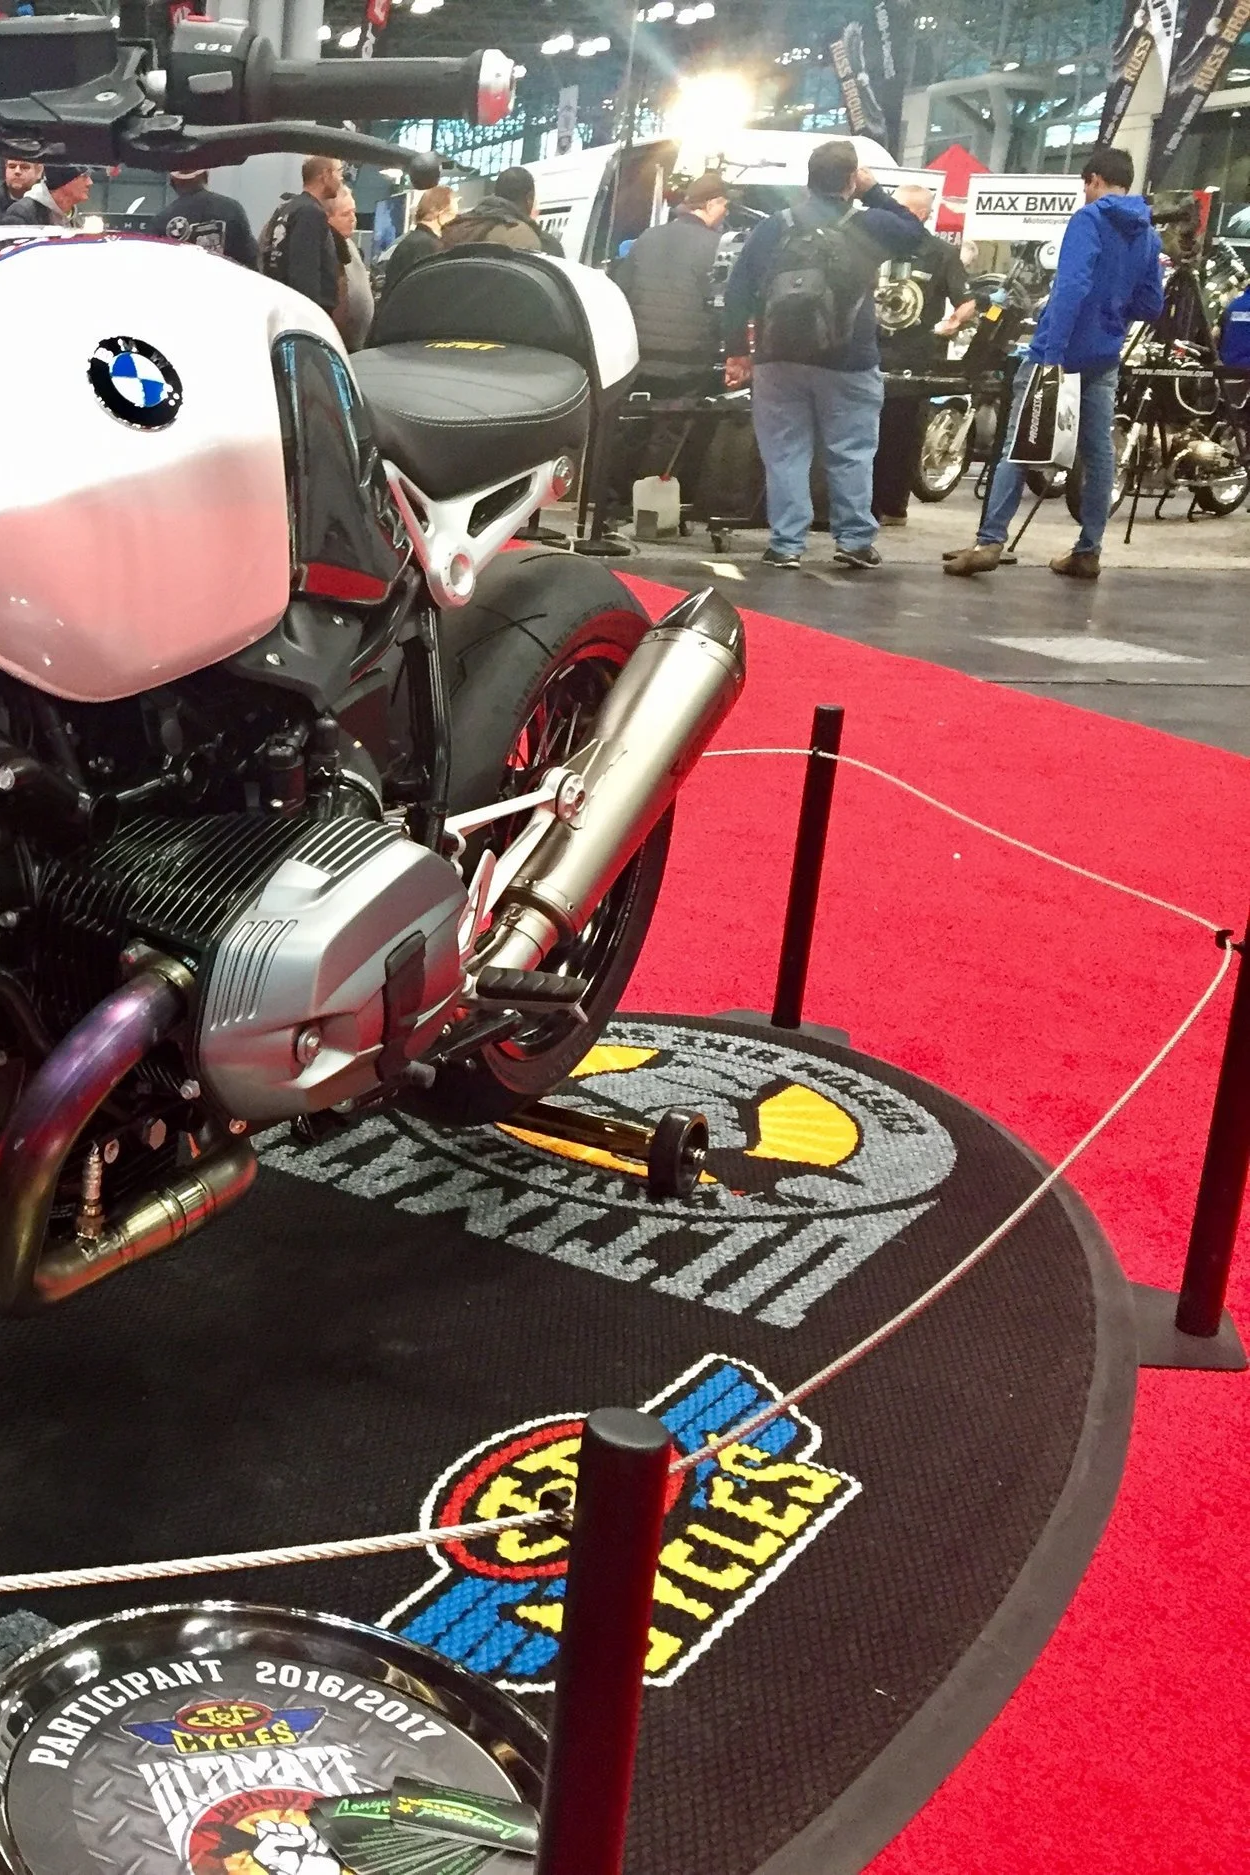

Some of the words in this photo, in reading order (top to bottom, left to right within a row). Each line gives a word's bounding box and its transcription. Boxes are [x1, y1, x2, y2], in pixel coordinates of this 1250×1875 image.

[1124, 34, 1152, 82] RUSS
[1193, 44, 1231, 93] RUSS
[842, 79, 866, 131] BROWN
[975, 195, 1020, 212] MAX
[1024, 195, 1077, 212] BMW
[1022, 217, 1070, 226] Motorcycle
[250, 1110, 941, 1330] ULTIMAT
[28, 1659, 224, 1769] PARTICIPANT
[255, 1661, 447, 1742] 2016/2017
[171, 1719, 299, 1753] CYCLES
[187, 1704, 261, 1728] J&P
[137, 1744, 375, 1863] ULTIMATE
